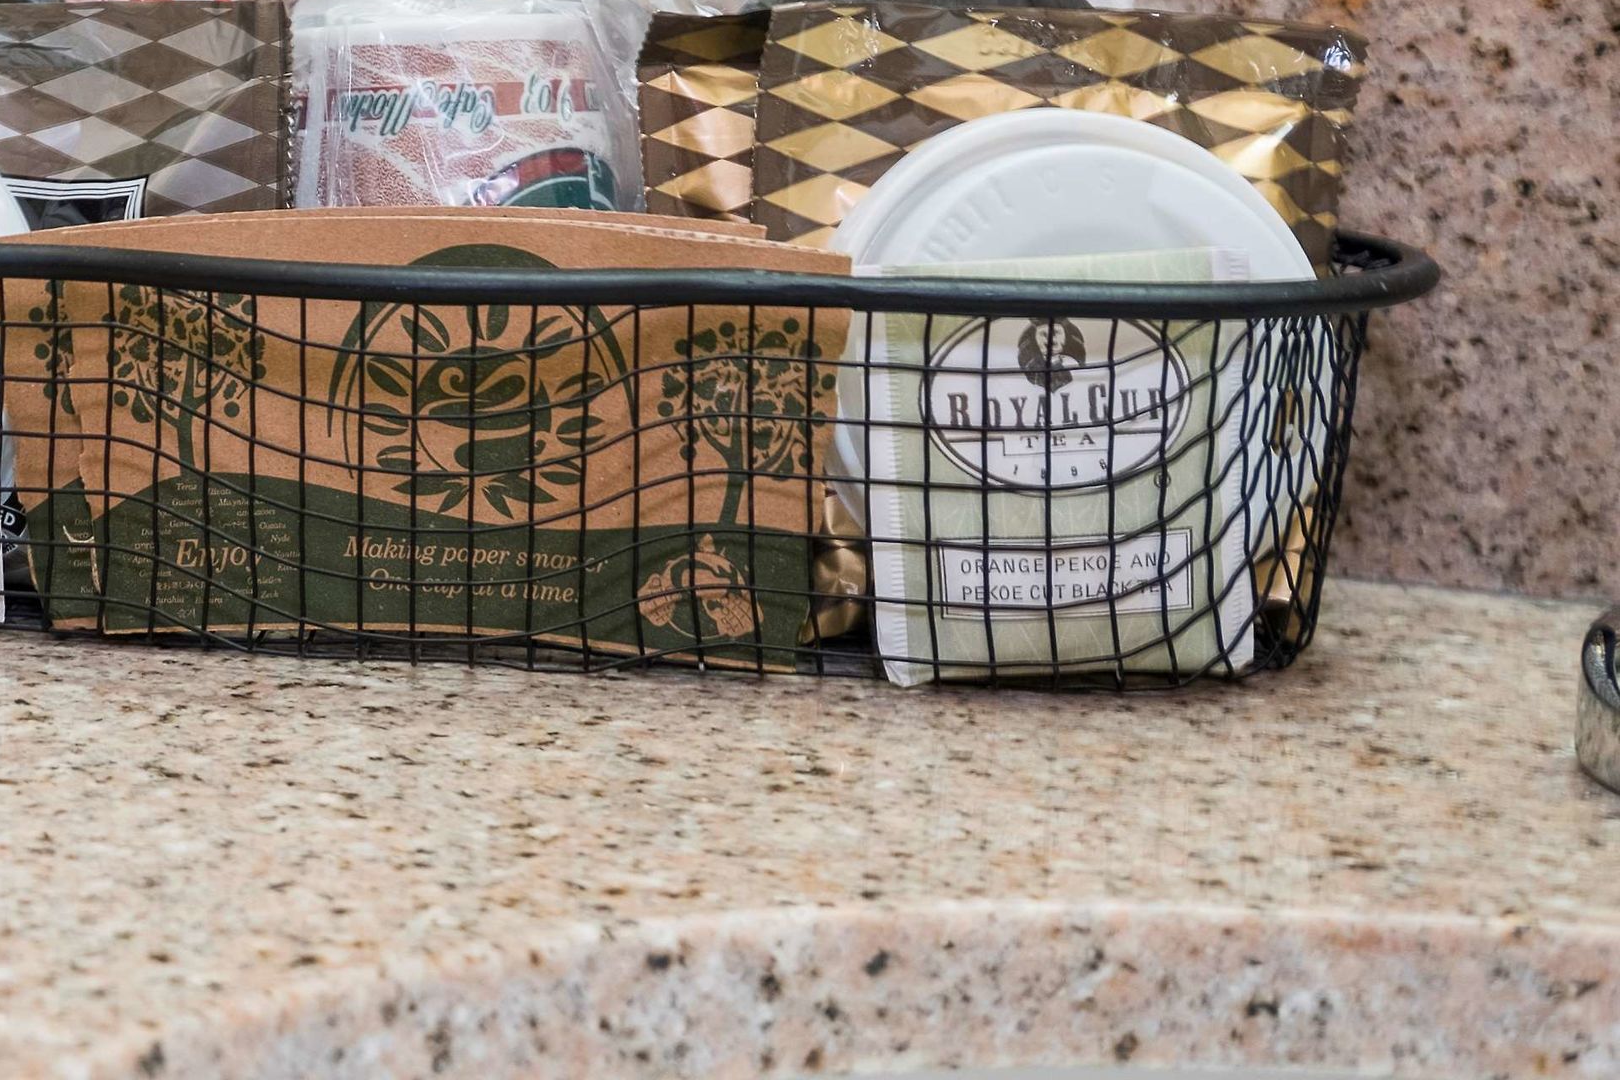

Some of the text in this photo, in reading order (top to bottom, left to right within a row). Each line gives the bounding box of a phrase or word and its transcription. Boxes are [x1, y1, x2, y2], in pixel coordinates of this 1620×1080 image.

[946, 391, 1079, 428] ROYAL
[1019, 432, 1096, 449] TEA
[175, 536, 264, 573] Enjoy
[343, 535, 610, 573] Making paper smarer
[960, 551, 1171, 574] ORANGE PEKOE AND
[962, 584, 1024, 602] PEKOE
